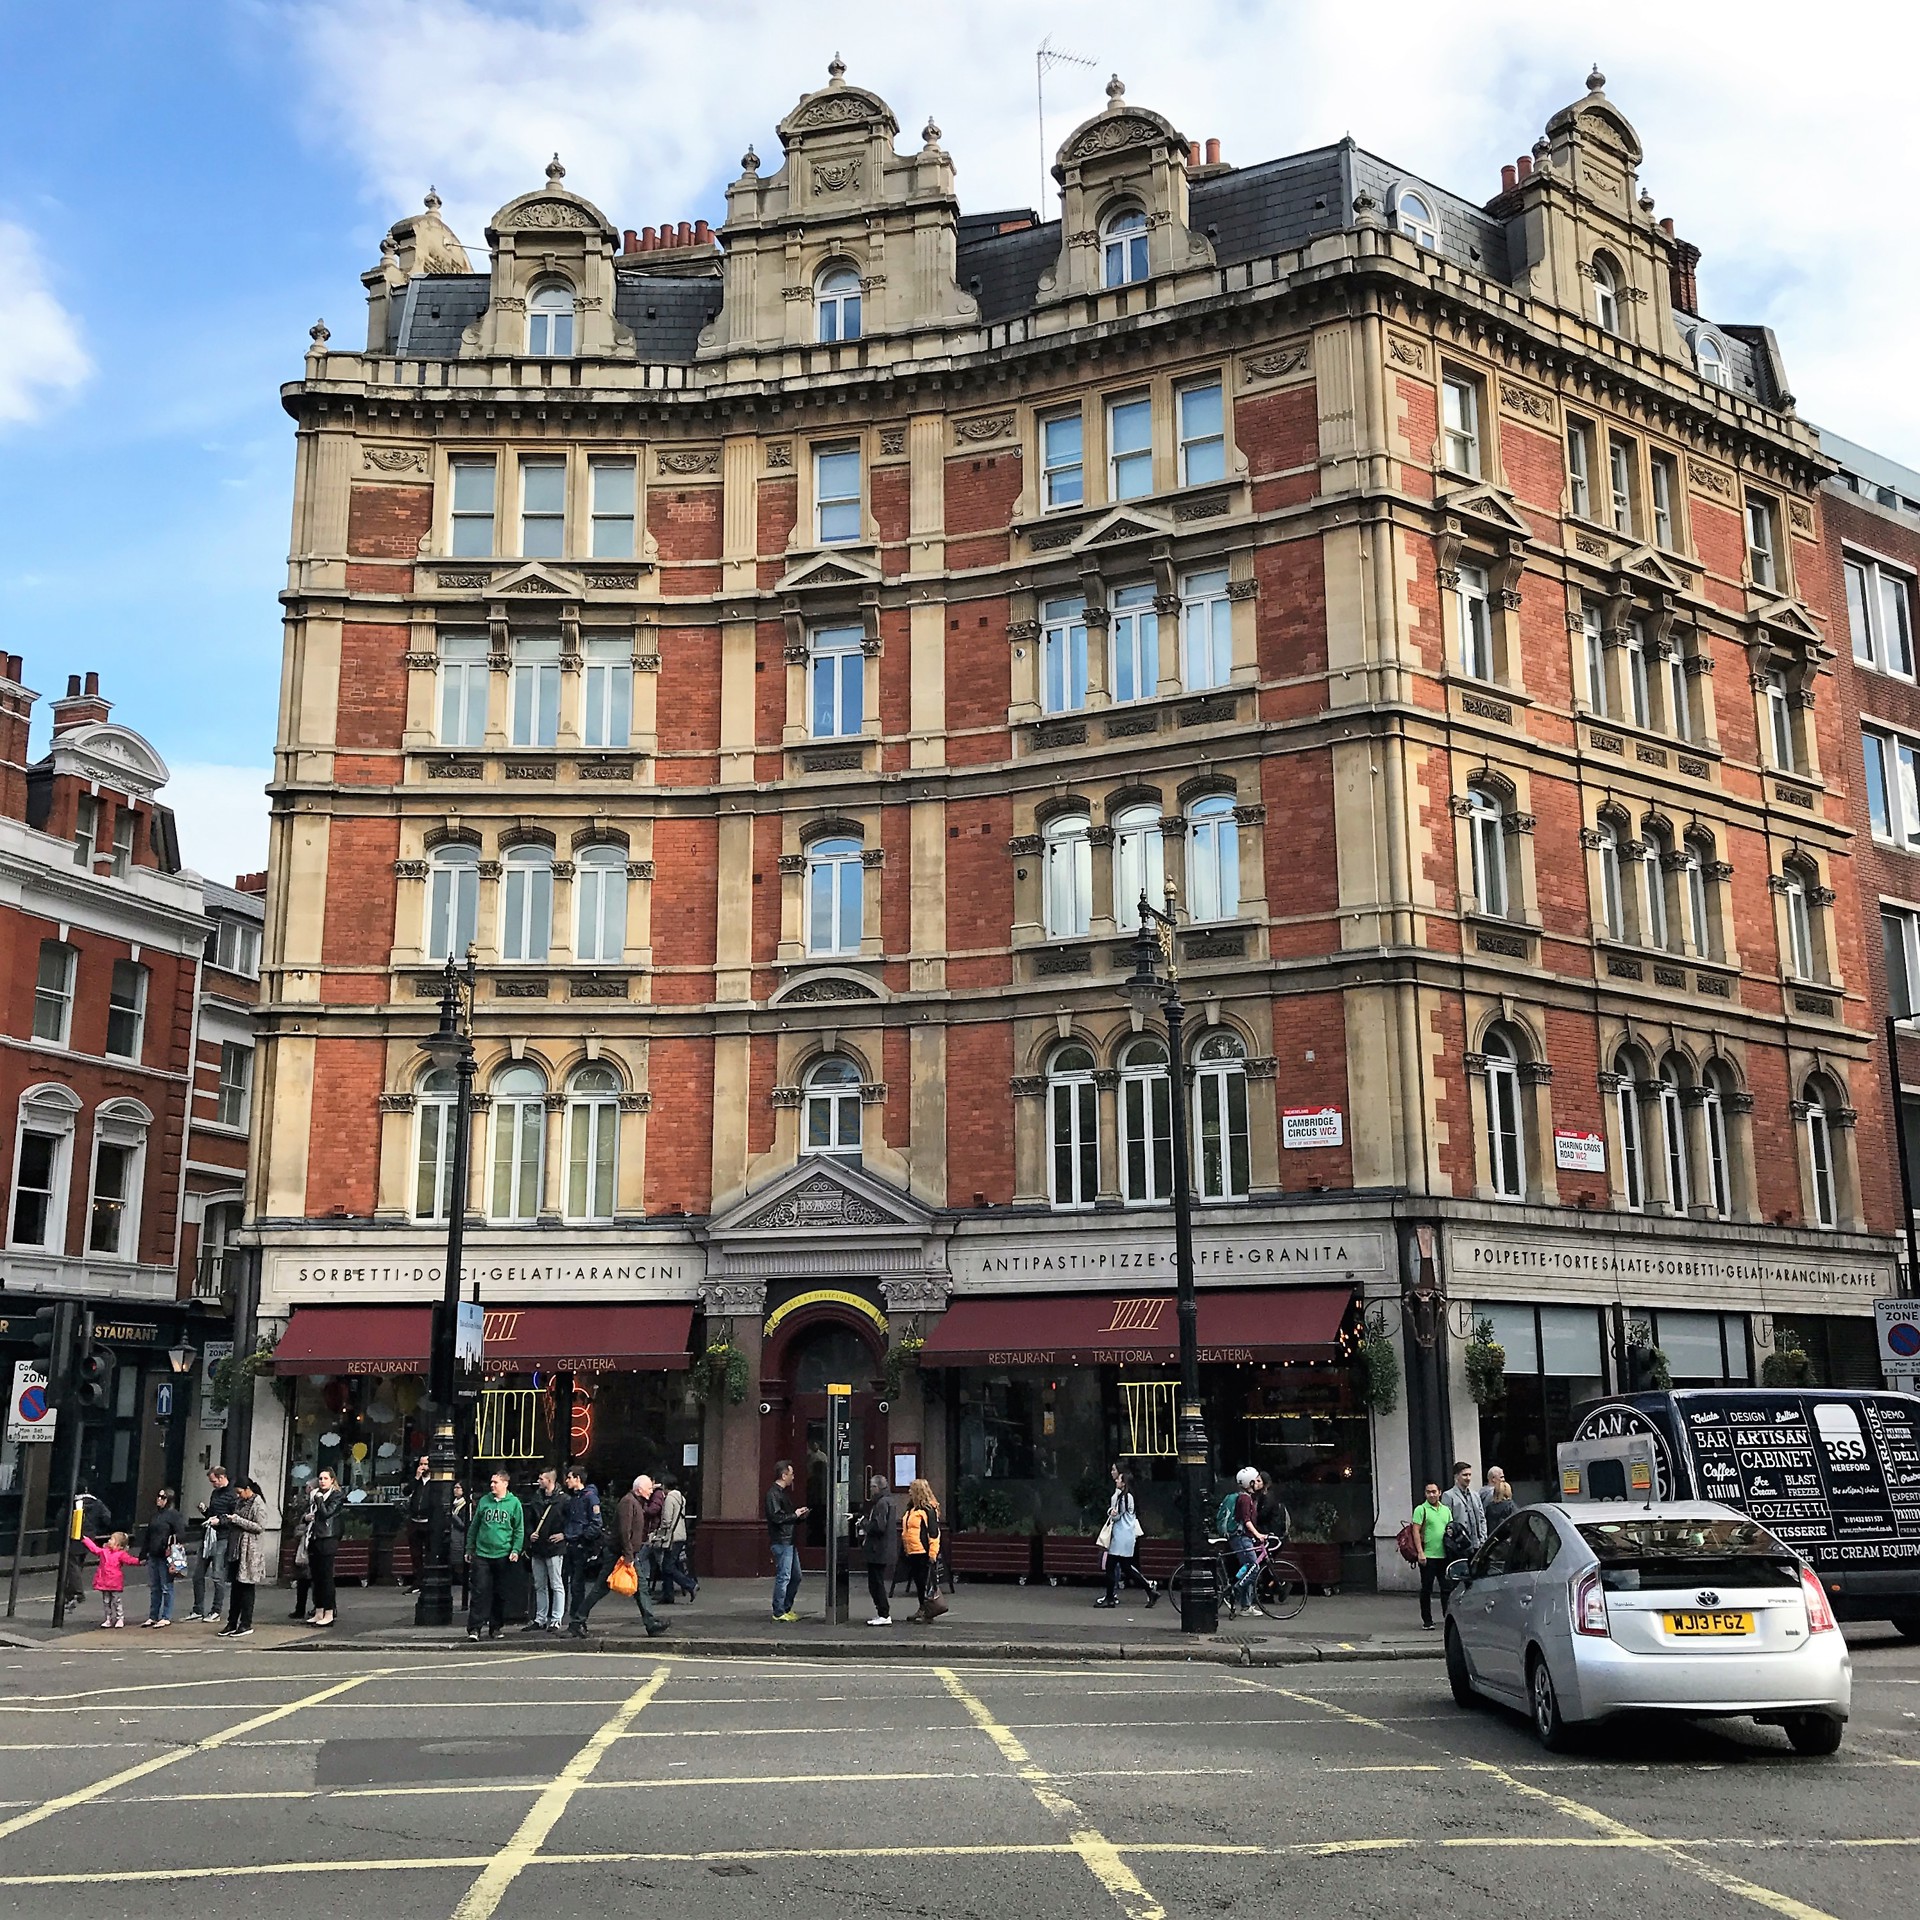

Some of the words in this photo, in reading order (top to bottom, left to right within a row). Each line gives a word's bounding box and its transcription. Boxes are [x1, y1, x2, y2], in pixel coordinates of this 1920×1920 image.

[1287, 1117, 1334, 1128] CAMBRIDGE
[1288, 1128, 1317, 1138] CIRCUS
[1320, 1126, 1337, 1136] WC2
[1559, 1140, 1583, 1151] CHARING
[1583, 1143, 1601, 1153] CROSS
[1559, 1149, 1575, 1159] ROAD
[1575, 1151, 1588, 1160] WC2
[982, 1255, 1086, 1273] ANTIPASTI
[1099, 1252, 1156, 1268] PIZZE
[1248, 1246, 1348, 1263] GRANITA
[1474, 1248, 1546, 1267] POLPETTE
[1554, 1253, 1598, 1270] TORTE
[1602, 1257, 1650, 1273] SALATE
[1658, 1260, 1720, 1277] SORBETTI
[1726, 1265, 1769, 1280] GELATI
[1775, 1268, 1836, 1285] ARANCINI
[299, 1268, 400, 1282] SORBETTI
[413, 1267, 476, 1281] DOCI
[490, 1267, 562, 1281] GELATI
[574, 1265, 682, 1280] ARANCINI
[1097, 1298, 1173, 1333] VICO
[1885, 1311, 1919, 1321] ZONE
[78, 1324, 159, 1341] STAURANT
[483, 1311, 526, 1342] ICO
[988, 1351, 1056, 1365] RESTAURANT
[1092, 1350, 1154, 1363] TRATTORIA
[347, 1361, 419, 1374] RESTAURANT
[483, 1360, 519, 1372] TORIA
[557, 1358, 616, 1370] GELATERIA
[22, 1373, 49, 1383] ZON
[1690, 1411, 1720, 1424] Gelato
[1729, 1411, 1766, 1422] DESIGN
[1774, 1410, 1800, 1423] Lollies
[1880, 1410, 1906, 1420] DEMO
[472, 1388, 547, 1460] VICO
[1694, 1431, 1730, 1448] BAR
[1736, 1429, 1809, 1446] ARTISAN
[1822, 1440, 1864, 1461] RSS
[1866, 1406, 1897, 1485] PARLOUR
[1740, 1450, 1813, 1469] CABINET
[1892, 1450, 1920, 1461] DELI
[1702, 1462, 1738, 1482] Coffee
[1830, 1463, 1871, 1472] HEREFORD
[1753, 1475, 1770, 1487] Ice
[1784, 1474, 1817, 1486] BLAST
[1706, 1483, 1741, 1499] STATION
[1749, 1485, 1778, 1497] Cream
[1787, 1487, 1820, 1497] FREEZER
[484, 1508, 509, 1523] GAP
[1751, 1502, 1827, 1518] POZZETTI
[1769, 1525, 1828, 1538] TISSERIE
[1819, 1547, 1839, 1560] ICE
[1840, 1545, 1881, 1559] CREAM
[1673, 1614, 1710, 1630] WJ13
[1713, 1613, 1746, 1630] FGZ
